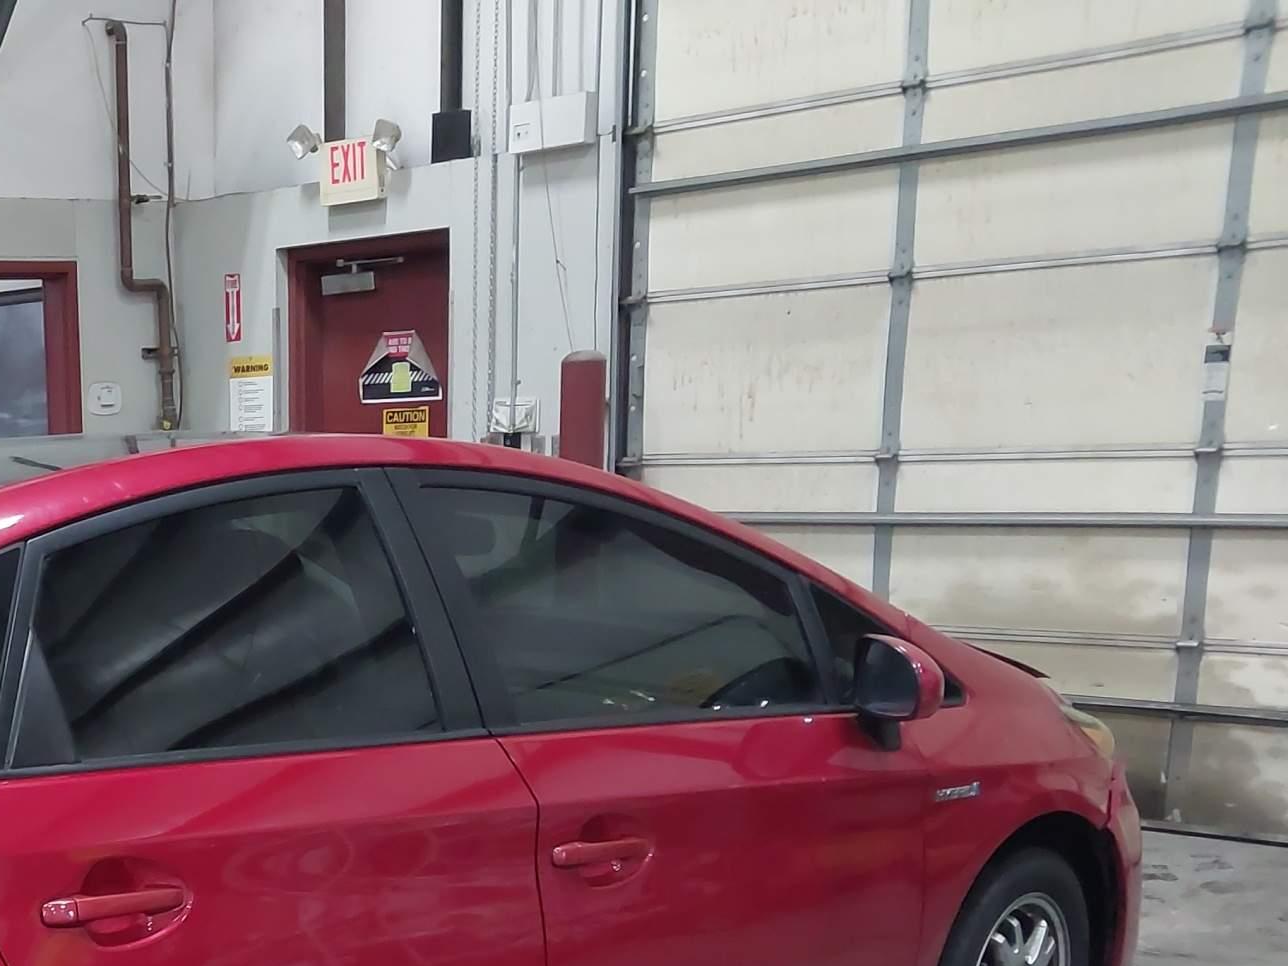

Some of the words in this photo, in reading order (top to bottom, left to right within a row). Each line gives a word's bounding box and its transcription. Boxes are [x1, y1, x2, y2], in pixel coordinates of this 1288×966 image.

[330, 141, 367, 184] EXIT
[233, 363, 269, 373] WARNING
[387, 411, 426, 423] CAUTION
